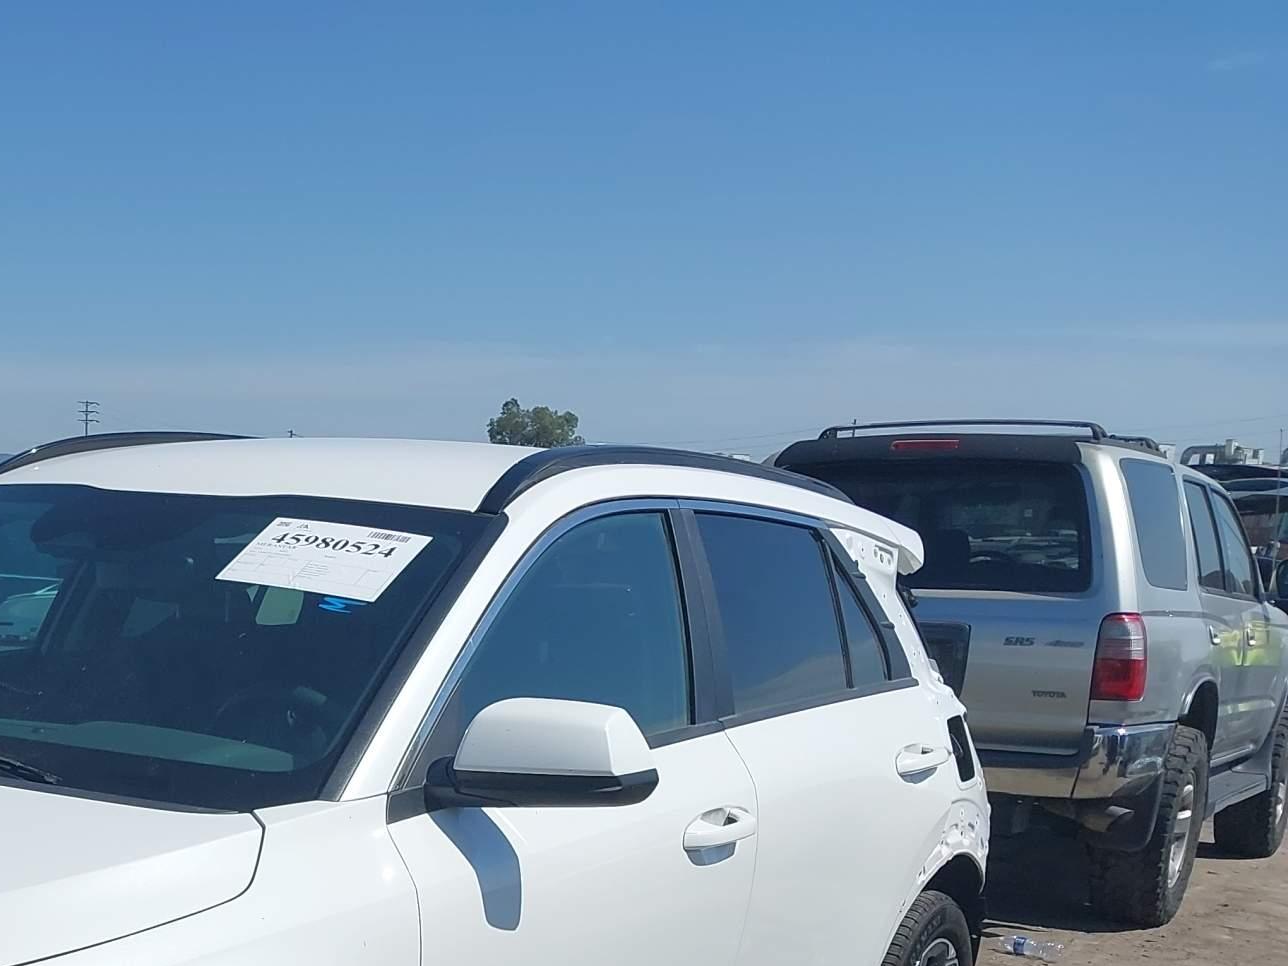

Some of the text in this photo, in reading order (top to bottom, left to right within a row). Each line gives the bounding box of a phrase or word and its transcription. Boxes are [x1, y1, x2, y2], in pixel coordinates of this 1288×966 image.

[272, 532, 397, 558] 45980524
[1003, 636, 1035, 647] SR5
[1032, 690, 1067, 699] TOYOTA
